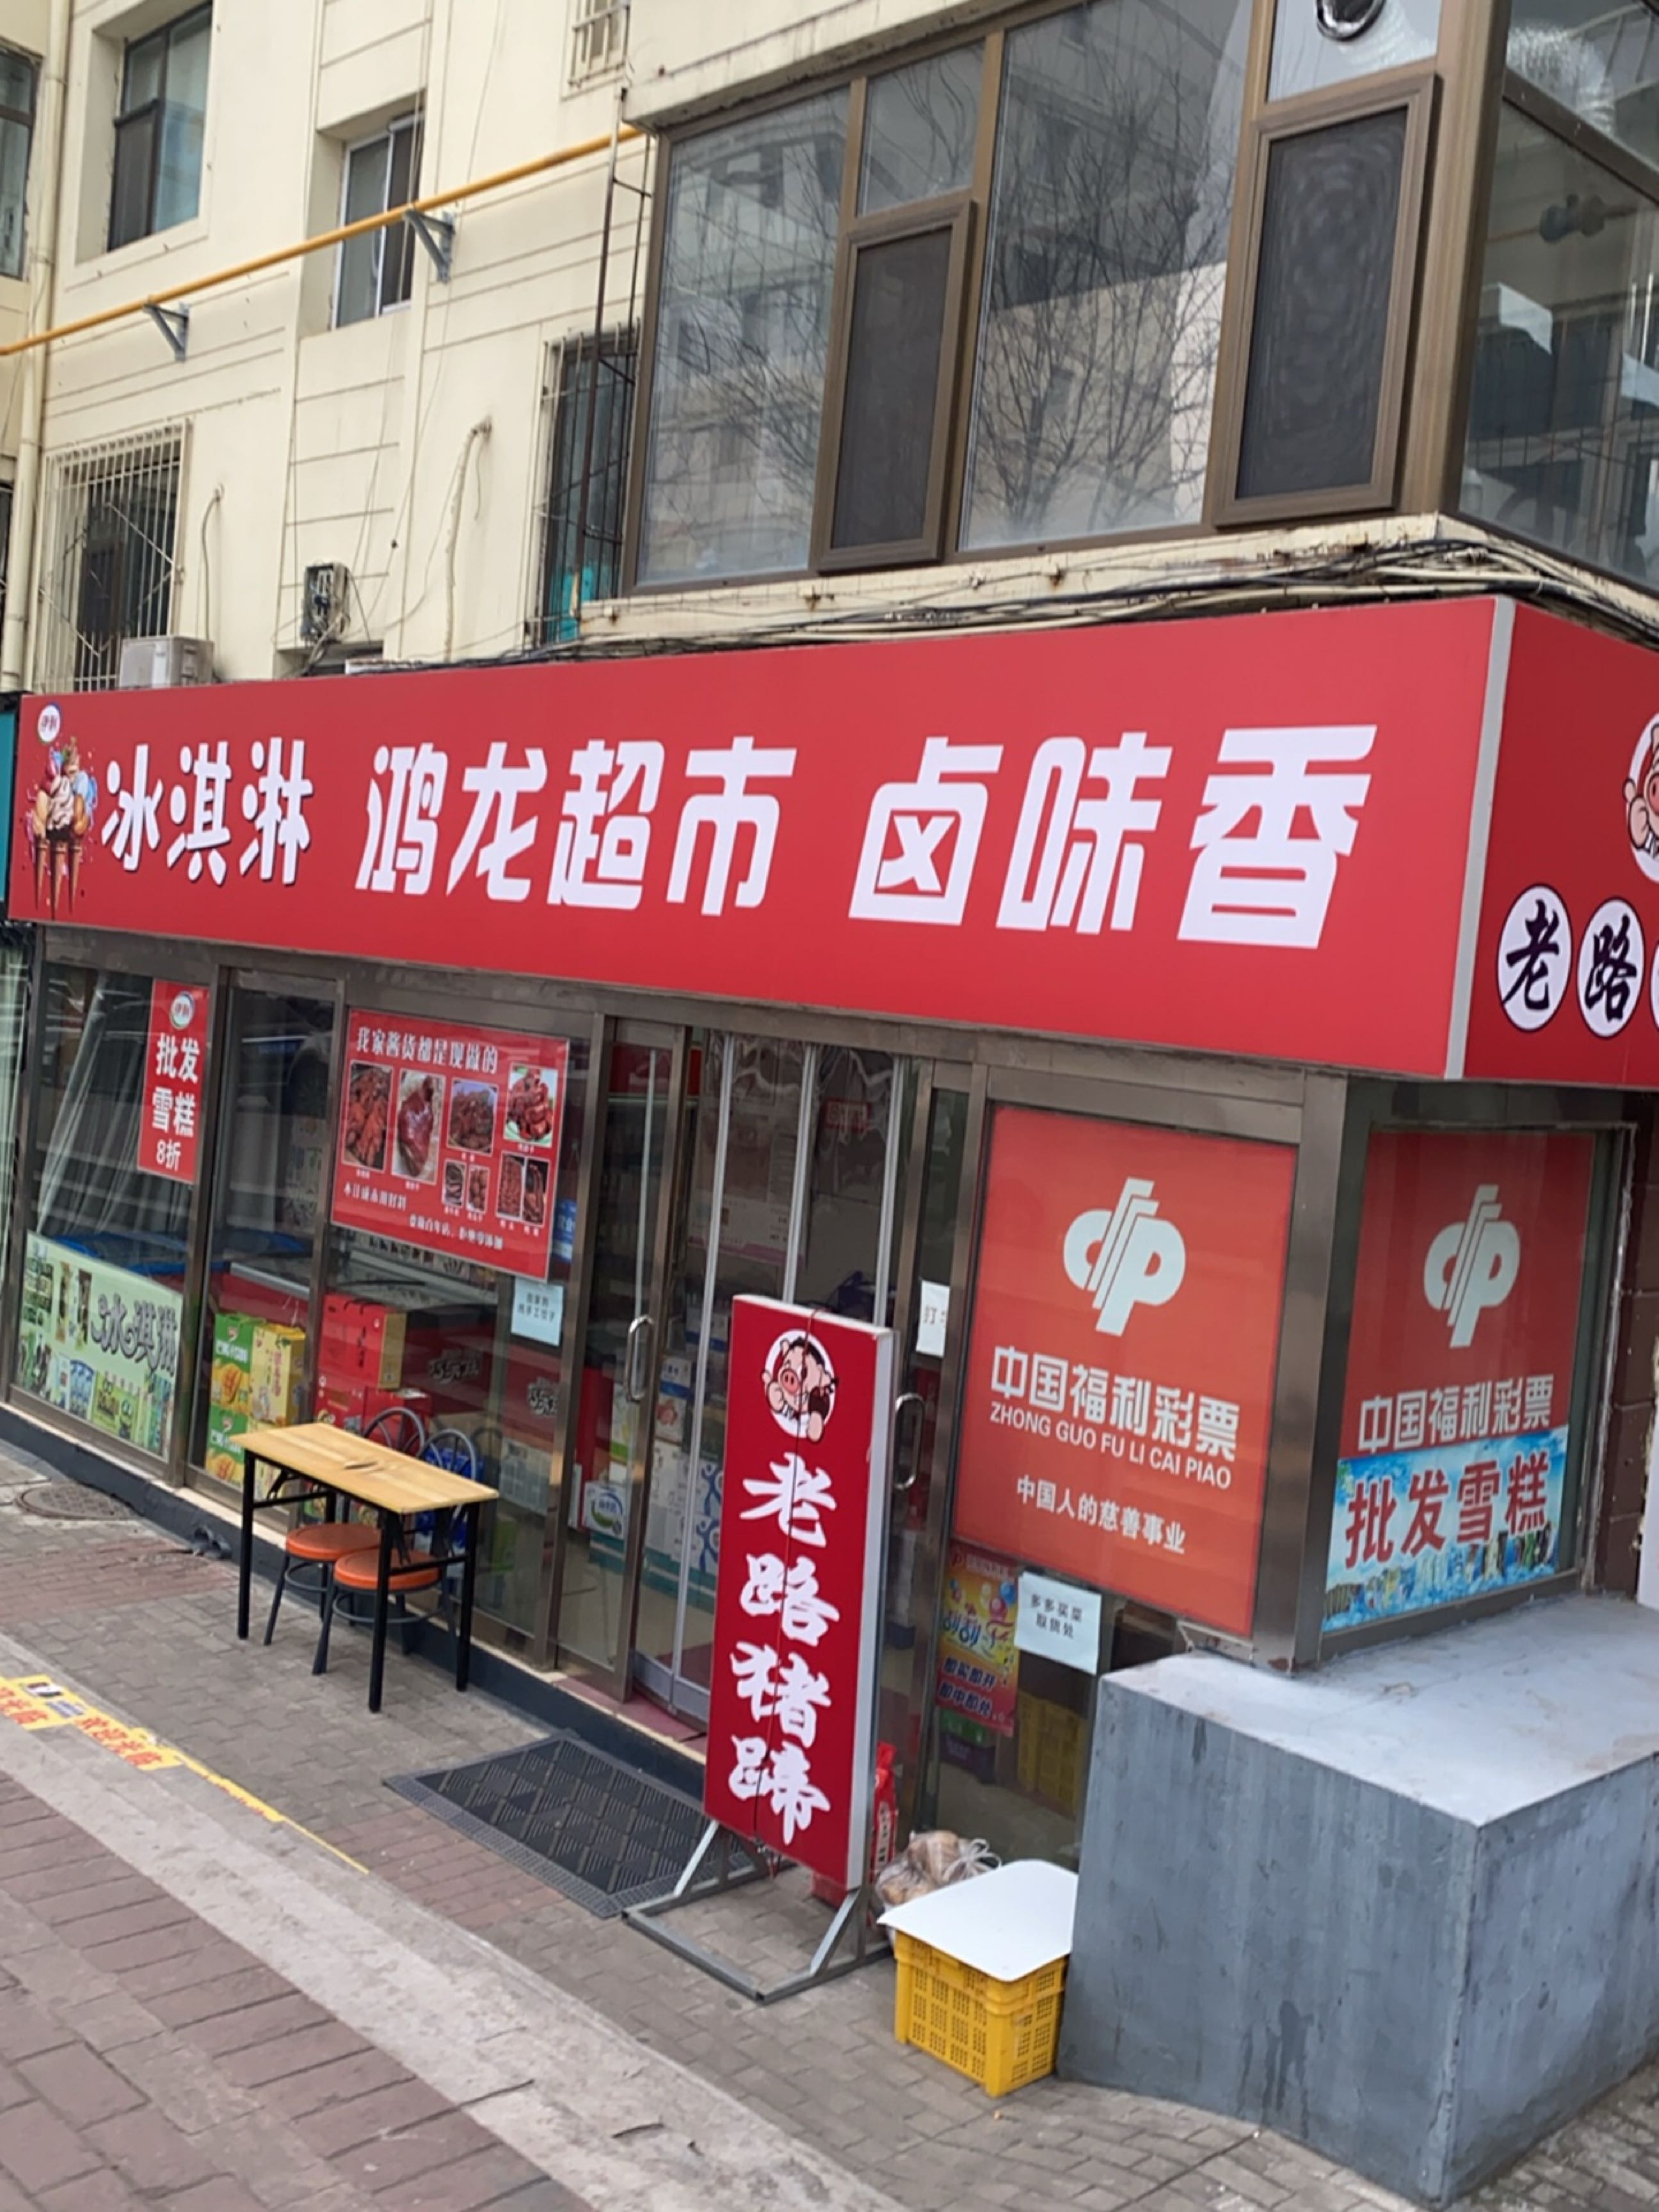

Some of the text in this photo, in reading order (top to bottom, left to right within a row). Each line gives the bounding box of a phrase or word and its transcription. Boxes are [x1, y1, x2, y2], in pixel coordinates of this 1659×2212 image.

[102, 725, 1377, 950] 冰淇淋 鸿龙超市 卤味香
[156, 1032, 200, 1083] 批发
[152, 1086, 195, 1138] 雪糕
[156, 1139, 181, 1171] 8折
[991, 1345, 1240, 1462] 中国福利彩票
[1358, 1374, 1554, 1454] 中国福利彩票
[990, 1402, 1232, 1490] ZHONG GUO FU LI CAI PIAO
[1016, 1474, 1186, 1555] 中国人的慈善事业
[1345, 1450, 1551, 1569] 批发雪糕
[728, 1452, 840, 1845] 老路猪蹄
[1030, 1594, 1084, 1624] 多多买菜
[1036, 1612, 1075, 1640] 取货处
